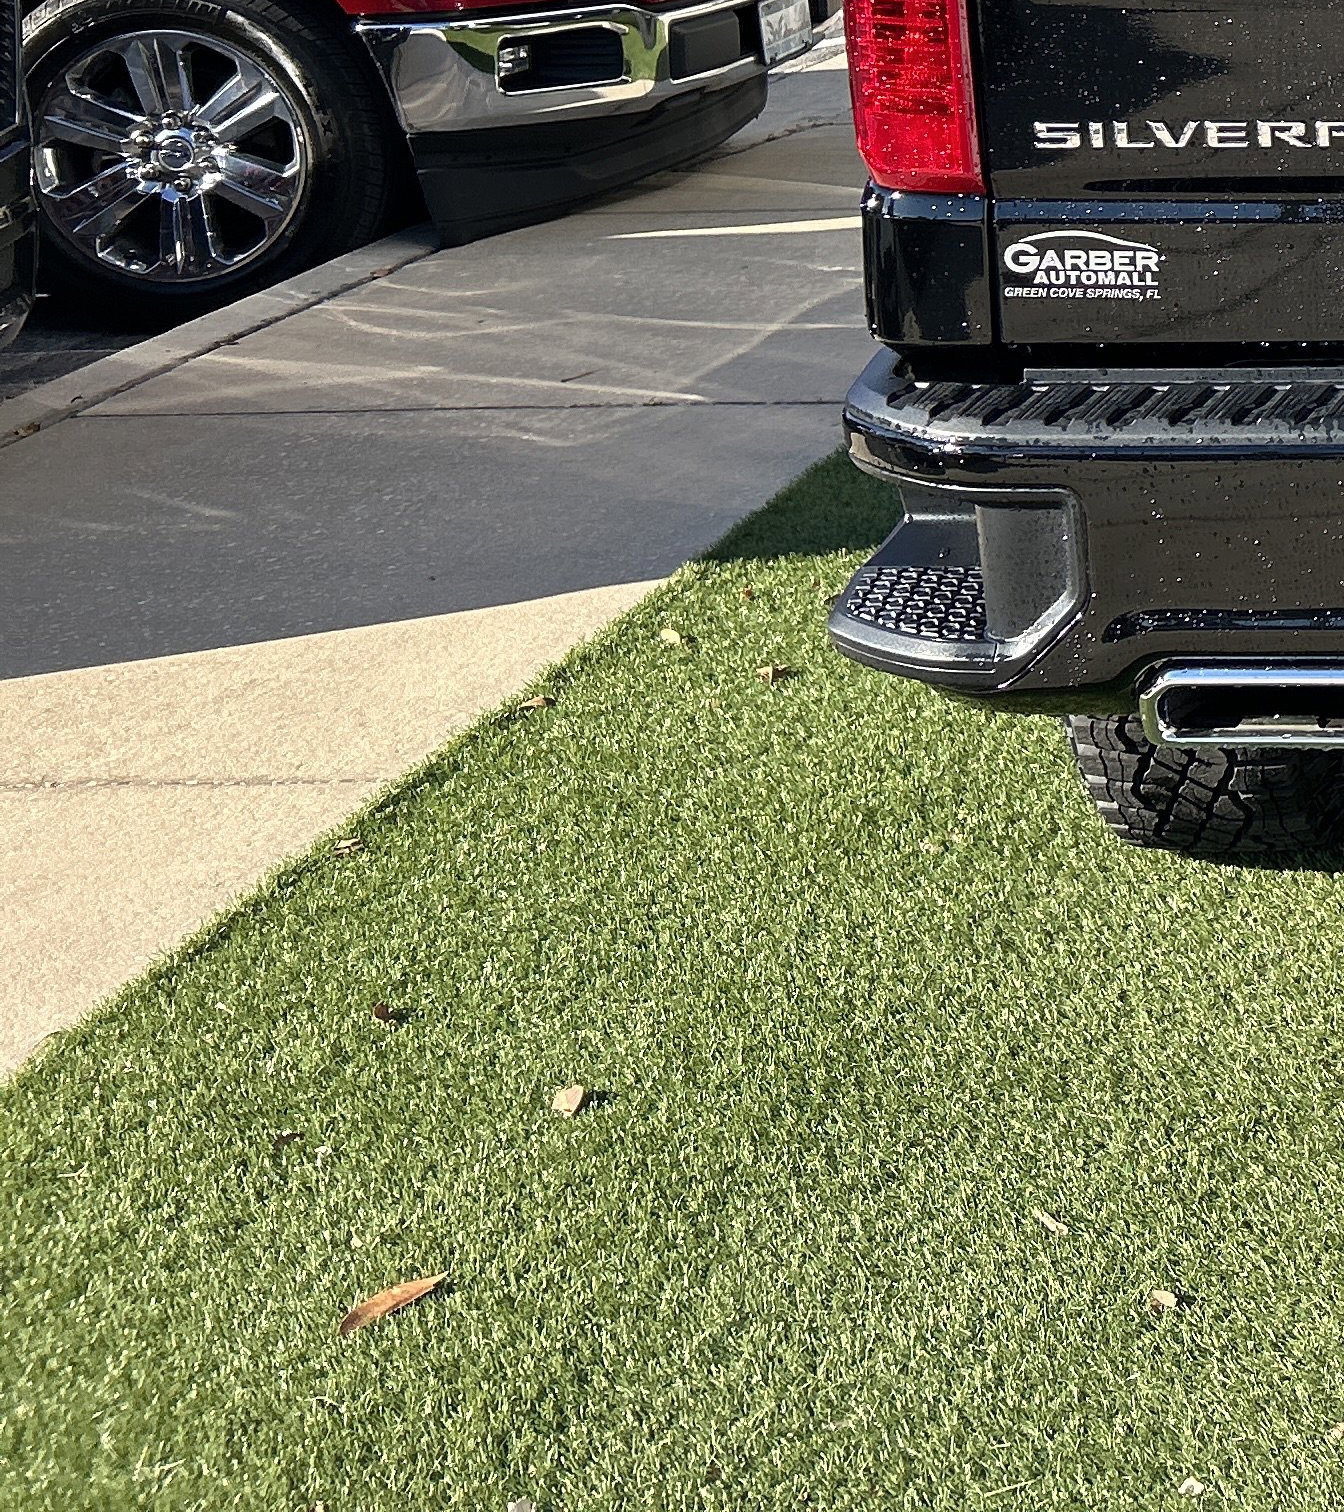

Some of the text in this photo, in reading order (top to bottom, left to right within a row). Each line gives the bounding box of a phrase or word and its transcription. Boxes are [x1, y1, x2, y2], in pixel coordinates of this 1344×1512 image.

[1003, 242, 1160, 274] GARBER
[1033, 271, 1159, 286] AUTOMALL
[1004, 287, 1162, 302] GREEN COVE SPRINGS, FL
